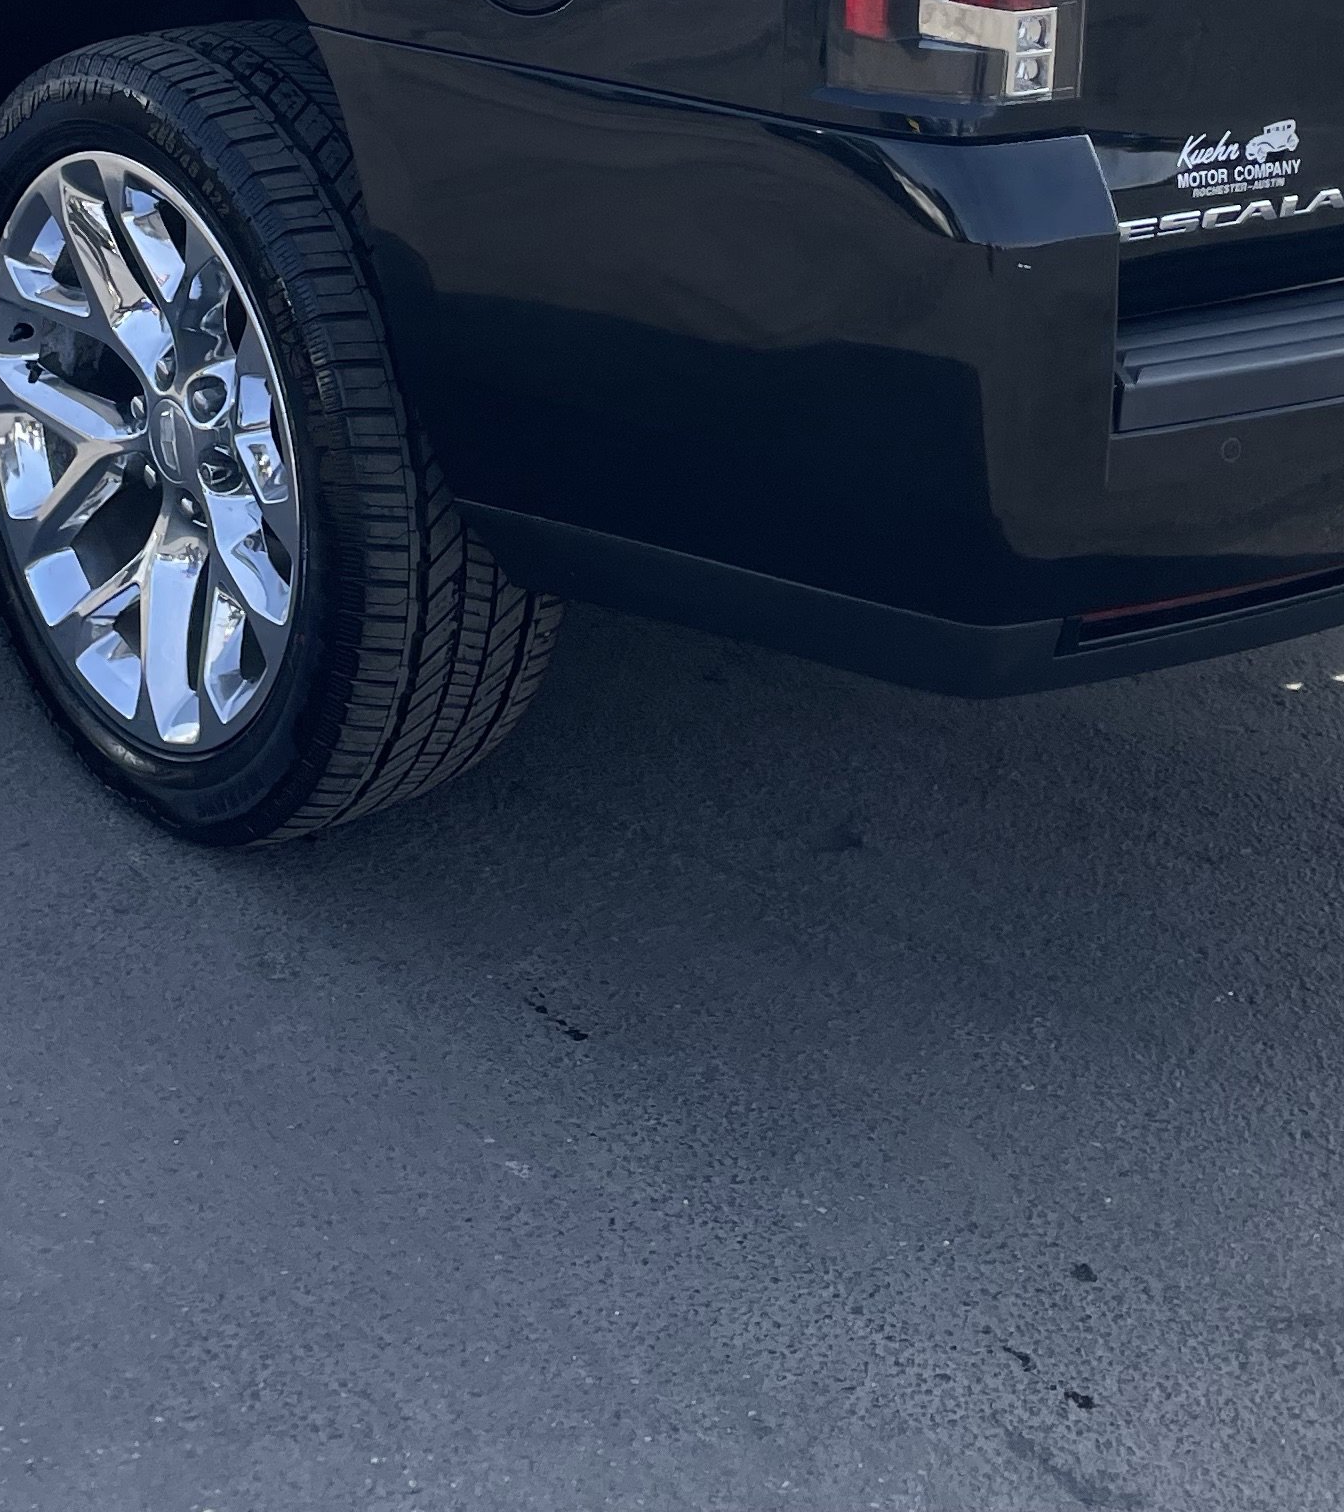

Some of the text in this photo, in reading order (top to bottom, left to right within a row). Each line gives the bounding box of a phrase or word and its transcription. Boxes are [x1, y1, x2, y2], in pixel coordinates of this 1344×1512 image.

[1177, 130, 1240, 169] Kuehn
[1177, 159, 1301, 188] MOTOR COMPANY
